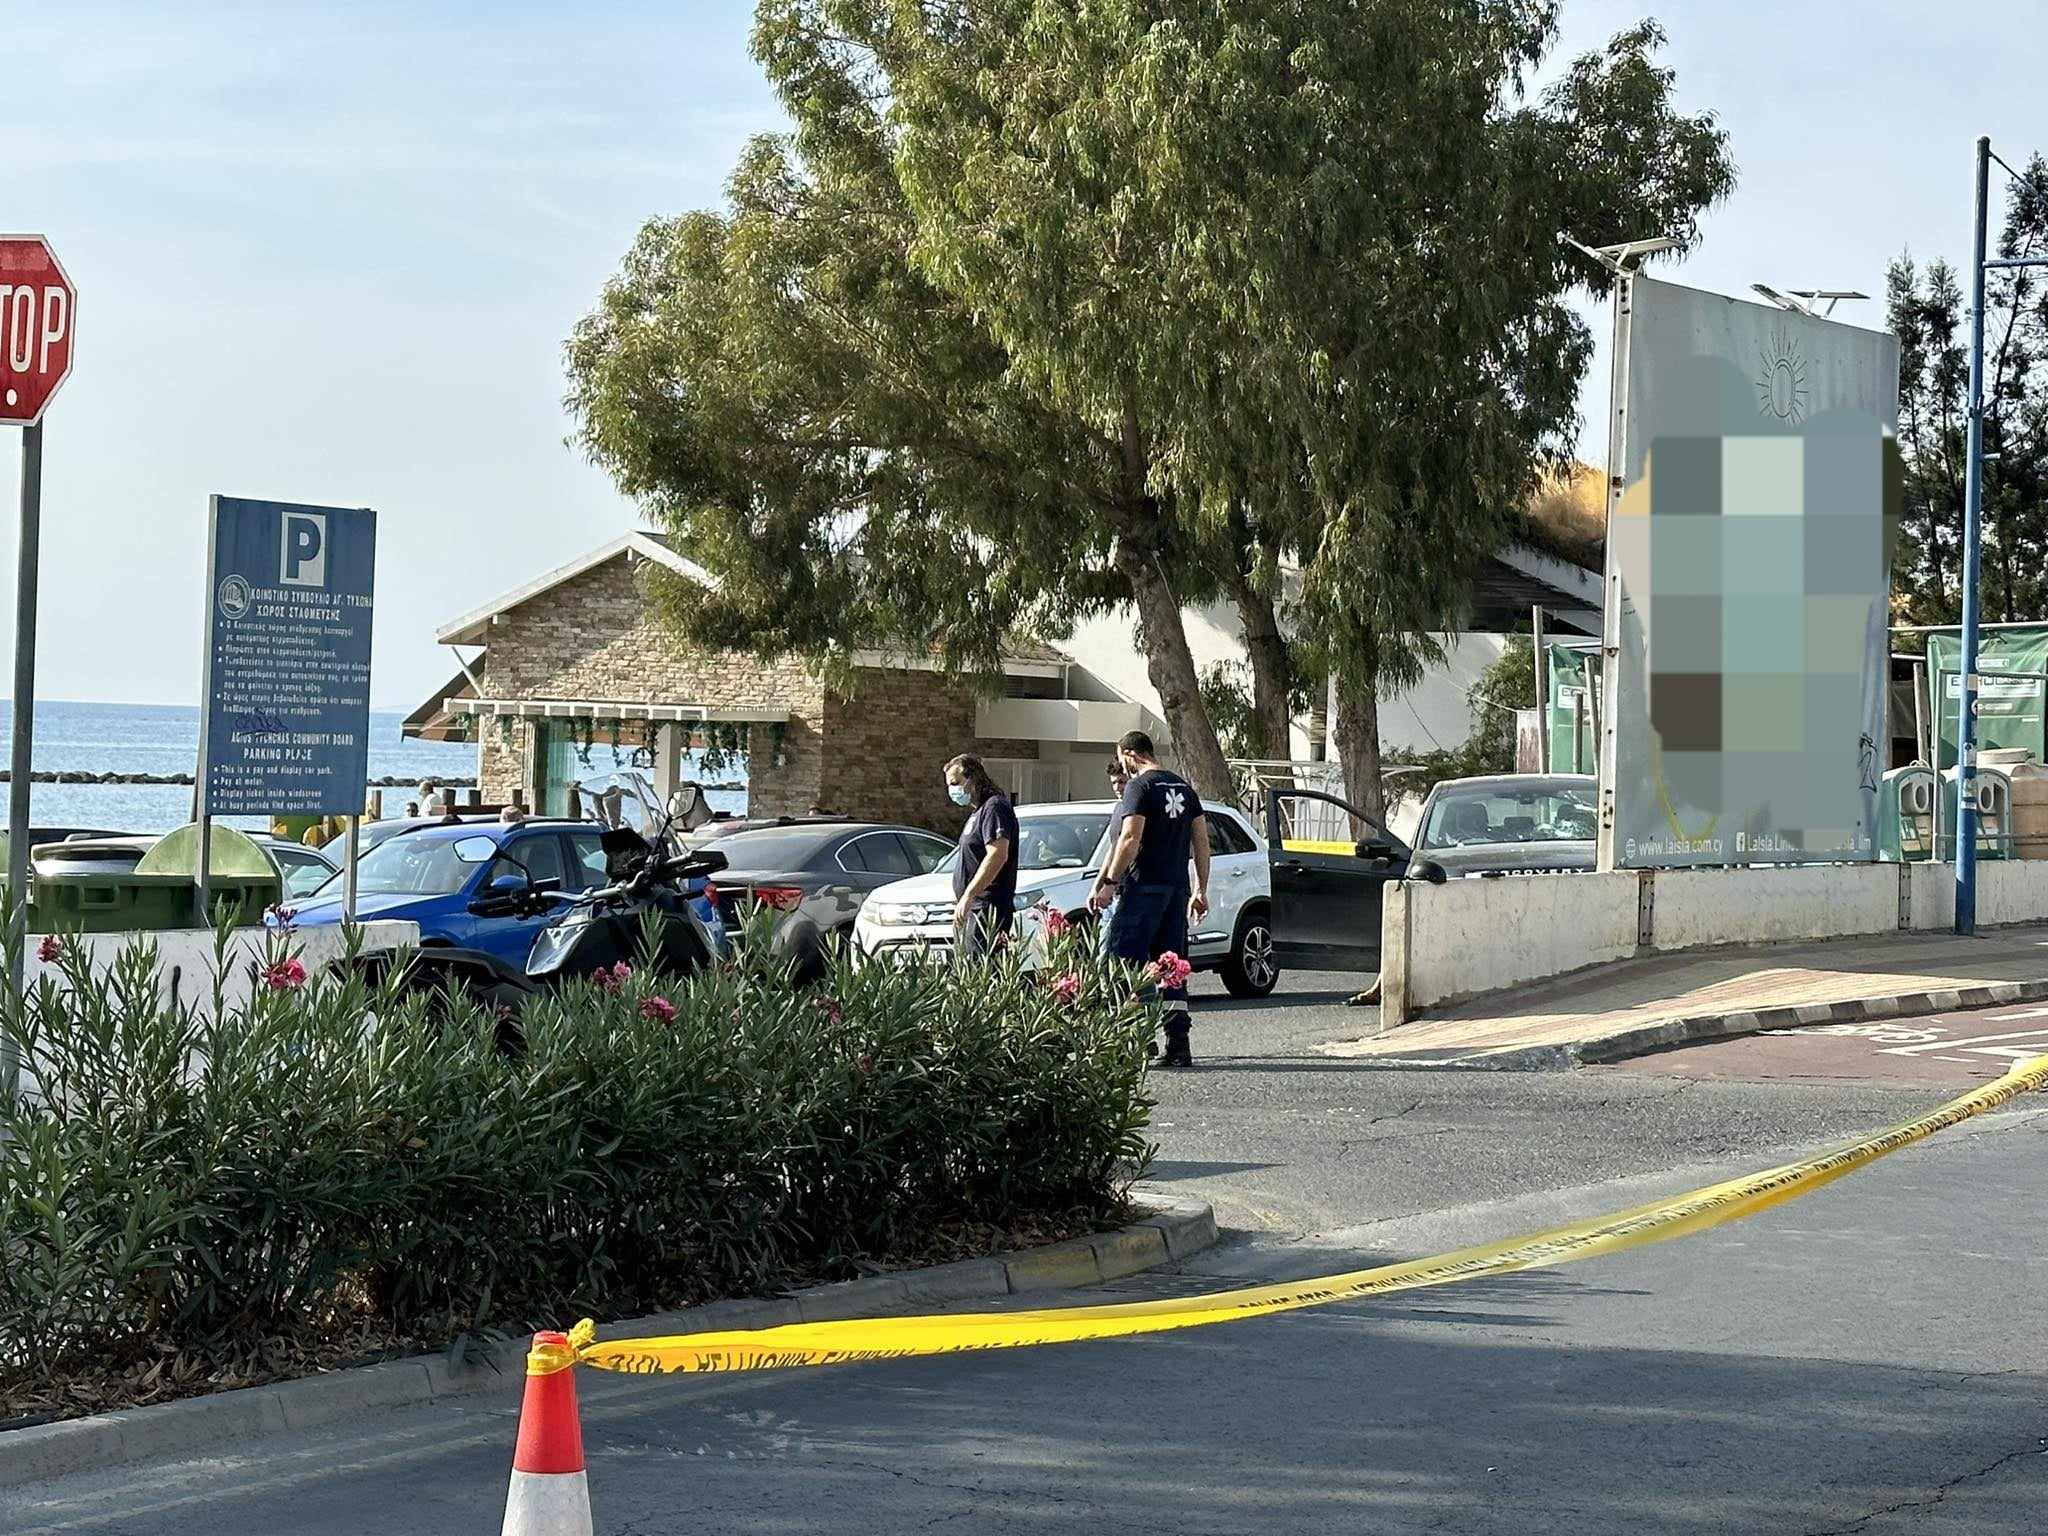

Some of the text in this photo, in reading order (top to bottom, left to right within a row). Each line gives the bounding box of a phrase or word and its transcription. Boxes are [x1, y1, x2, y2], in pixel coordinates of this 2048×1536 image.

[286, 517, 321, 579] P
[256, 604, 284, 618] ΧΩΡΟΣ
[244, 748, 313, 761] PARKING PLACE
